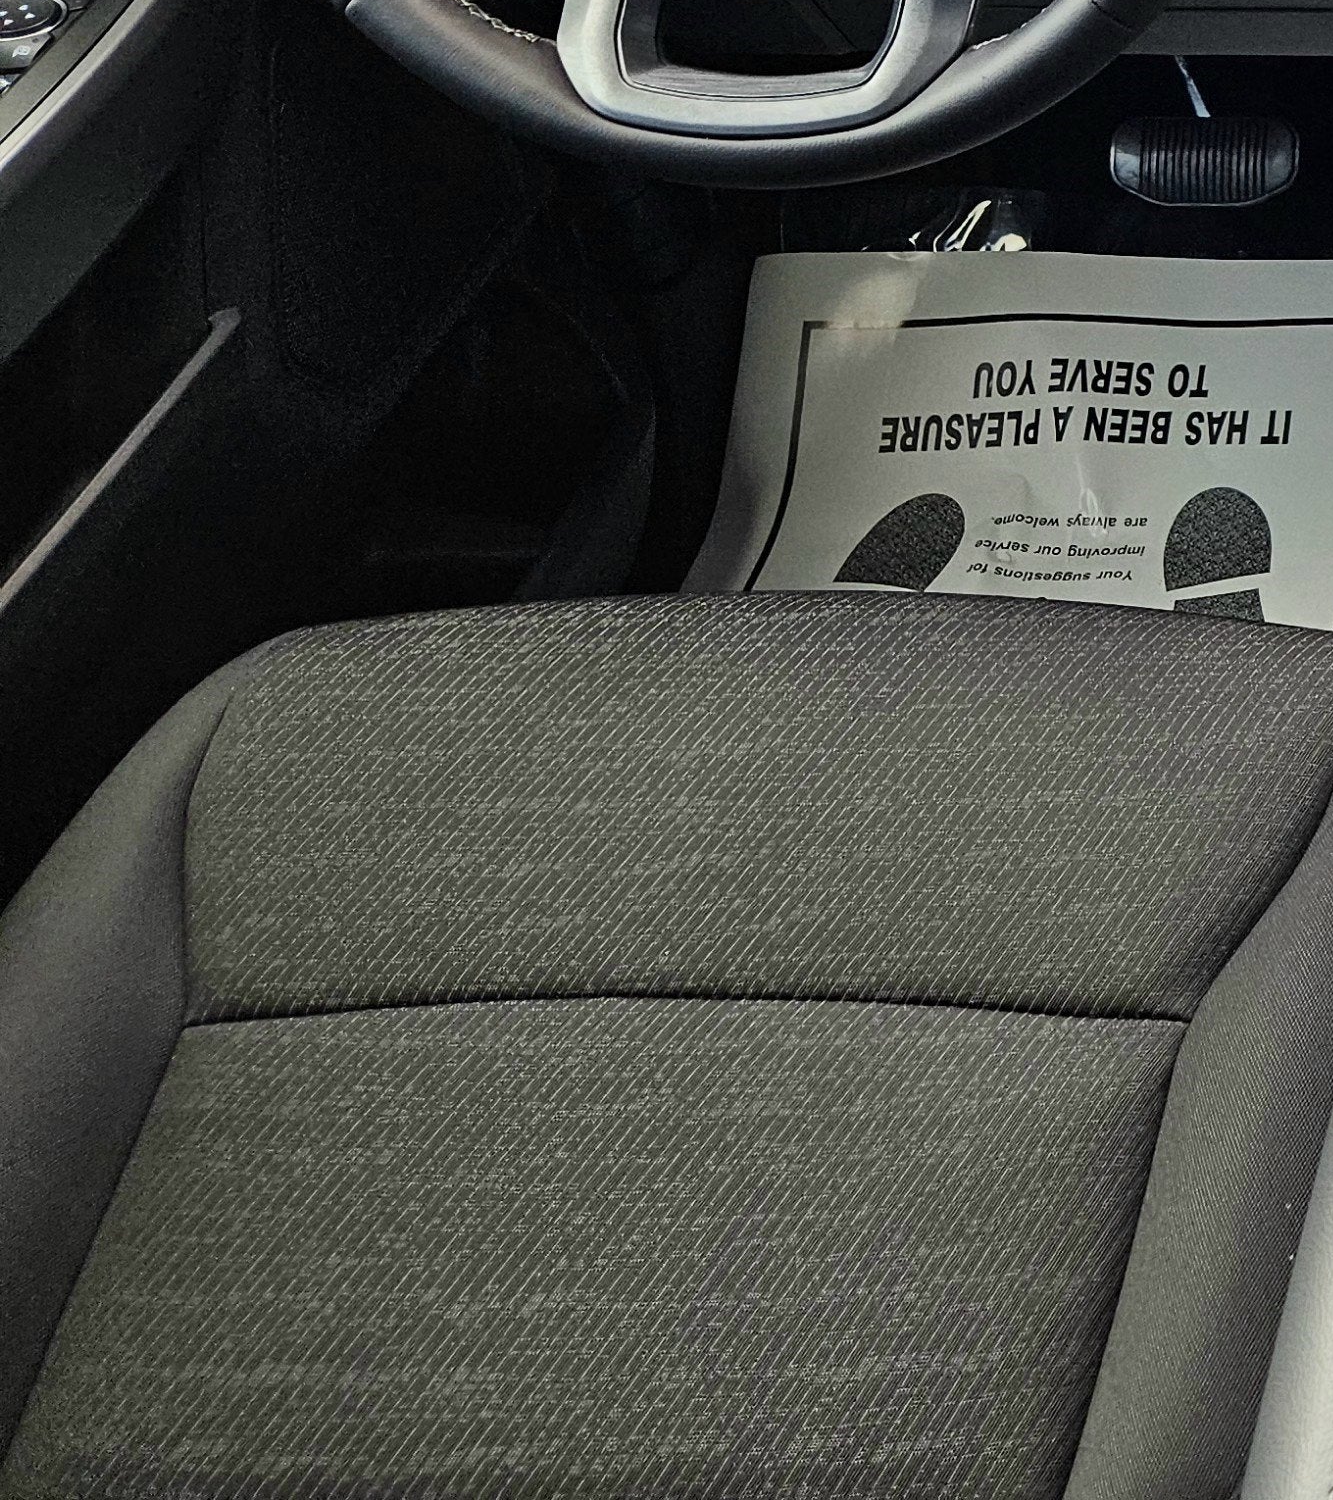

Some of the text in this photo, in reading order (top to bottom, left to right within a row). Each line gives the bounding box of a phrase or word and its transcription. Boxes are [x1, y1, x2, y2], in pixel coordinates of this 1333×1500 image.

[972, 356, 1211, 400] TO SERVE YOU
[878, 406, 1294, 455] IT HAS BEEN A PLEASURE
[990, 513, 1060, 528] welcome.
[1123, 516, 1148, 528] are
[974, 538, 1146, 560] improving our service
[966, 562, 1133, 584] Your suggestions for
